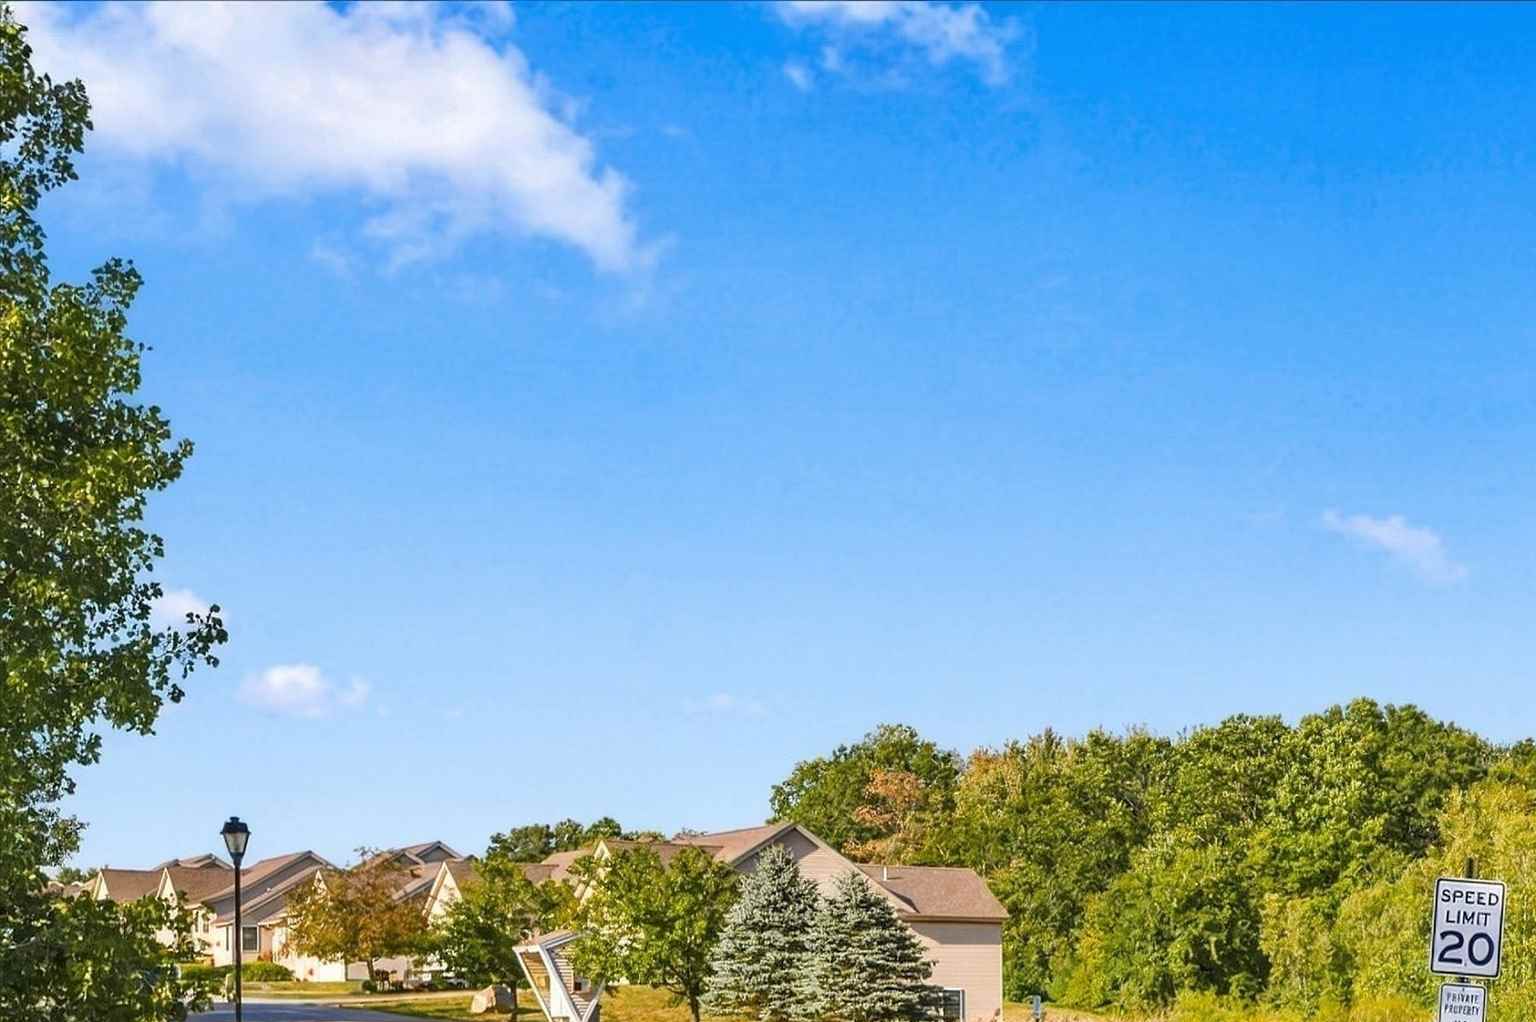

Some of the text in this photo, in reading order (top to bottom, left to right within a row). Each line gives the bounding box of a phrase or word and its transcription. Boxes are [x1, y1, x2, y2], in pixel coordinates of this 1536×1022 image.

[1441, 889, 1499, 906] SPEED
[1446, 910, 1491, 927] LIMIT
[1438, 930, 1495, 966] 20
[1447, 992, 1479, 1004] PRIVATE
[1445, 1004, 1480, 1016] PROPERTY
